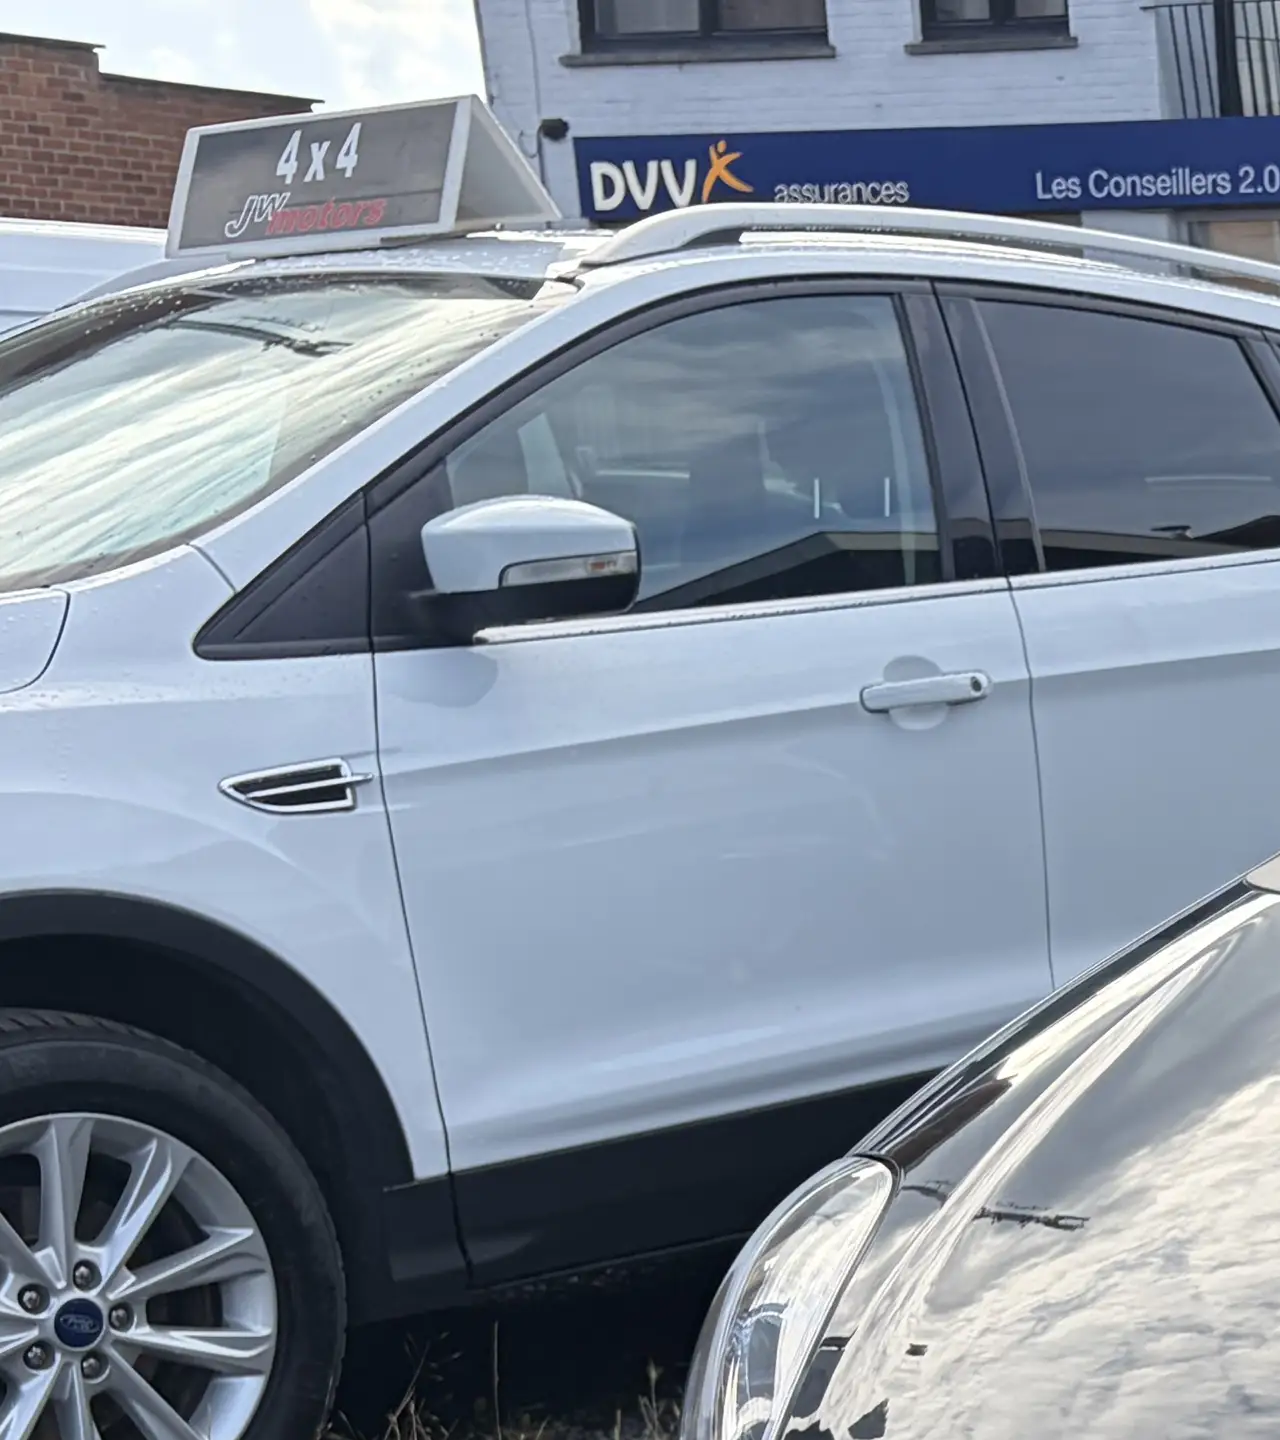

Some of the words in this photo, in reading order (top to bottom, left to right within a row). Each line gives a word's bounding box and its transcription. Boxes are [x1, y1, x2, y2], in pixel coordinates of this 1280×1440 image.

[590, 158, 697, 211] DVV
[773, 180, 909, 204] assurances
[1036, 170, 1082, 199] Les
[1088, 167, 1232, 198] Conseillers
[1238, 164, 1280, 194] 2.0
[225, 192, 291, 238] JW
[265, 196, 388, 236] motors
